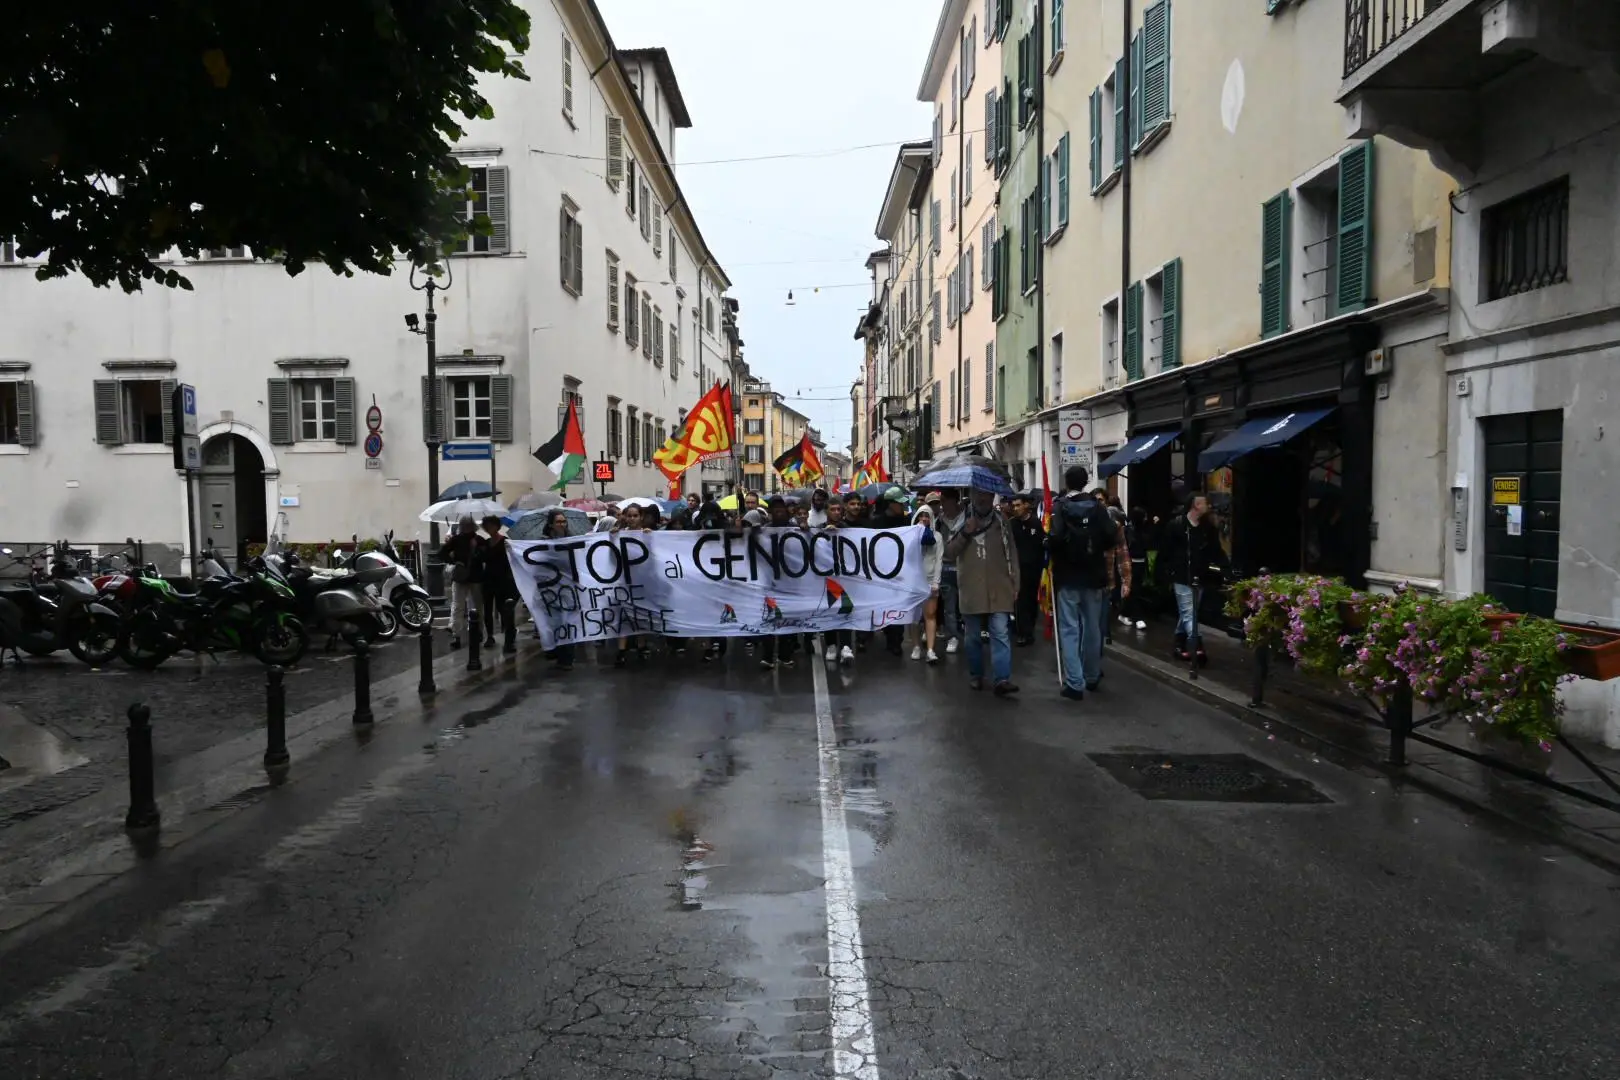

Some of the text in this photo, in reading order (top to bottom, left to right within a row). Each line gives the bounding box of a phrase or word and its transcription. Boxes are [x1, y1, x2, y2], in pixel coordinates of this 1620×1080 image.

[186, 392, 192, 412] P
[596, 464, 612, 472] ZTL
[1494, 480, 1517, 490] VENDESI
[523, 532, 905, 588] STOP al GENOCIDIO
